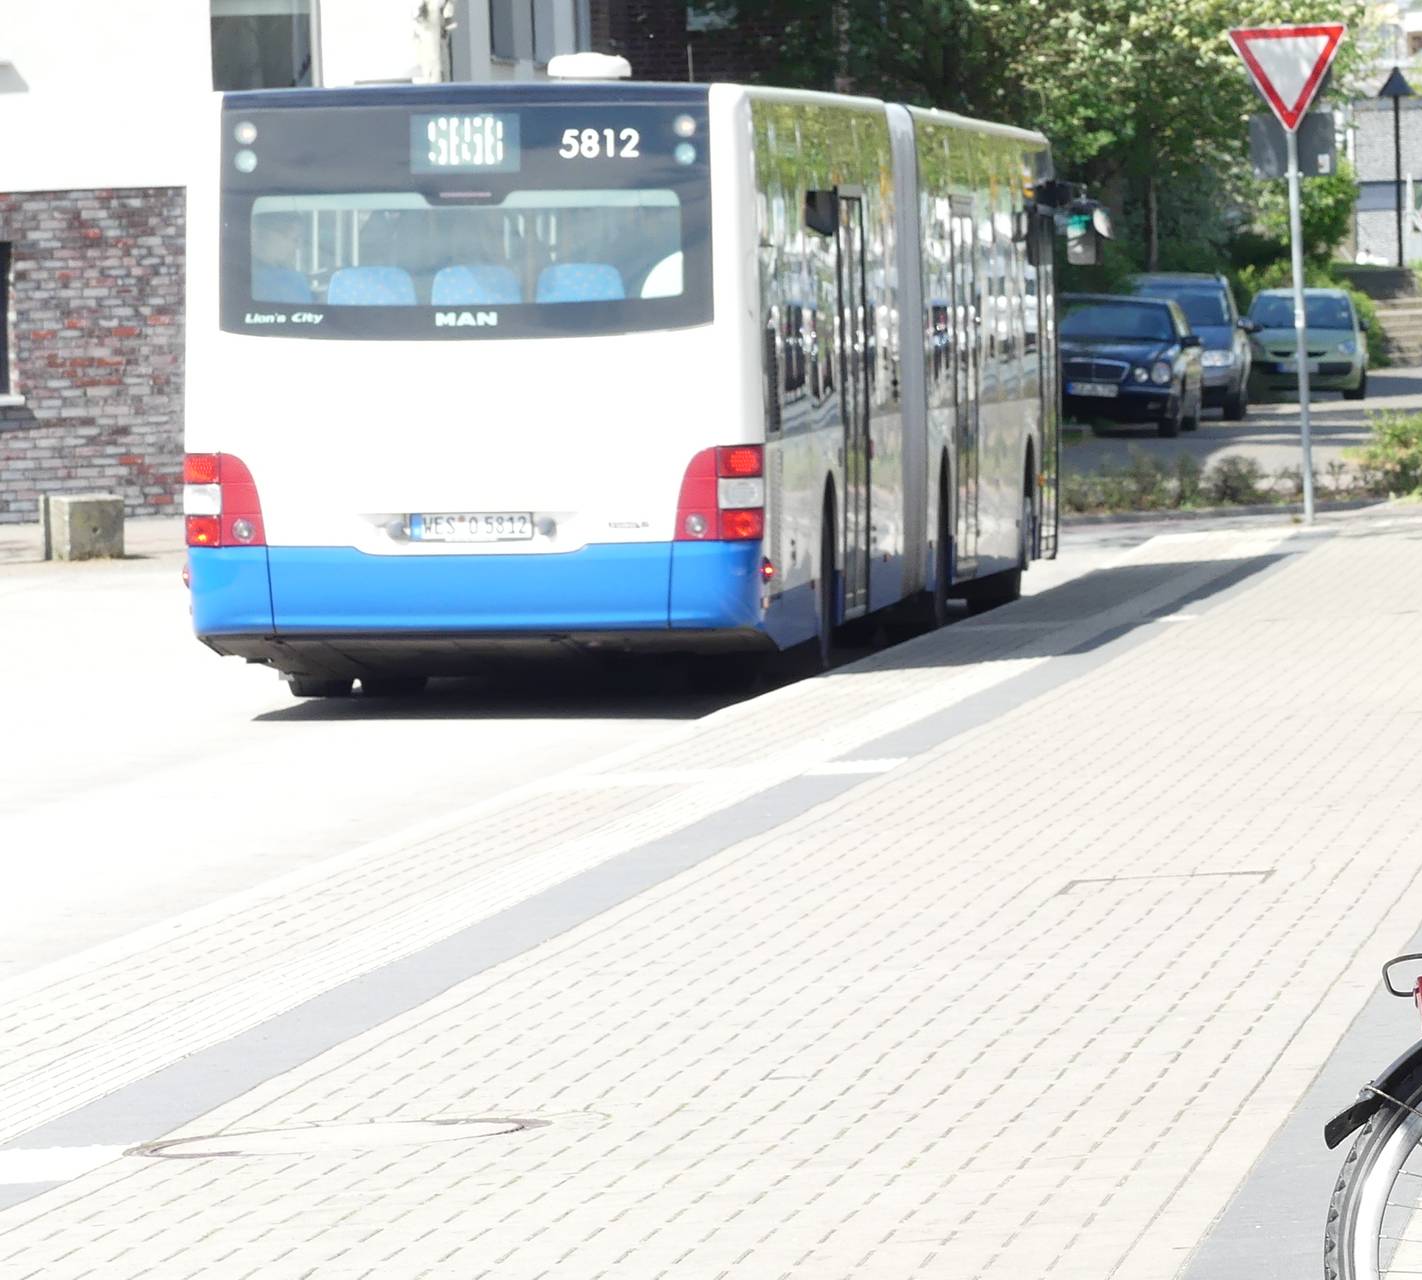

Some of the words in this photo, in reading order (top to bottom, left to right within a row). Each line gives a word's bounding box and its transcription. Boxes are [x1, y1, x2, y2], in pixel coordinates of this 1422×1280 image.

[559, 127, 640, 159] 5812
[291, 311, 324, 325] City
[435, 311, 498, 327] MAN
[423, 515, 456, 535] WES
[484, 514, 528, 535] 5812
